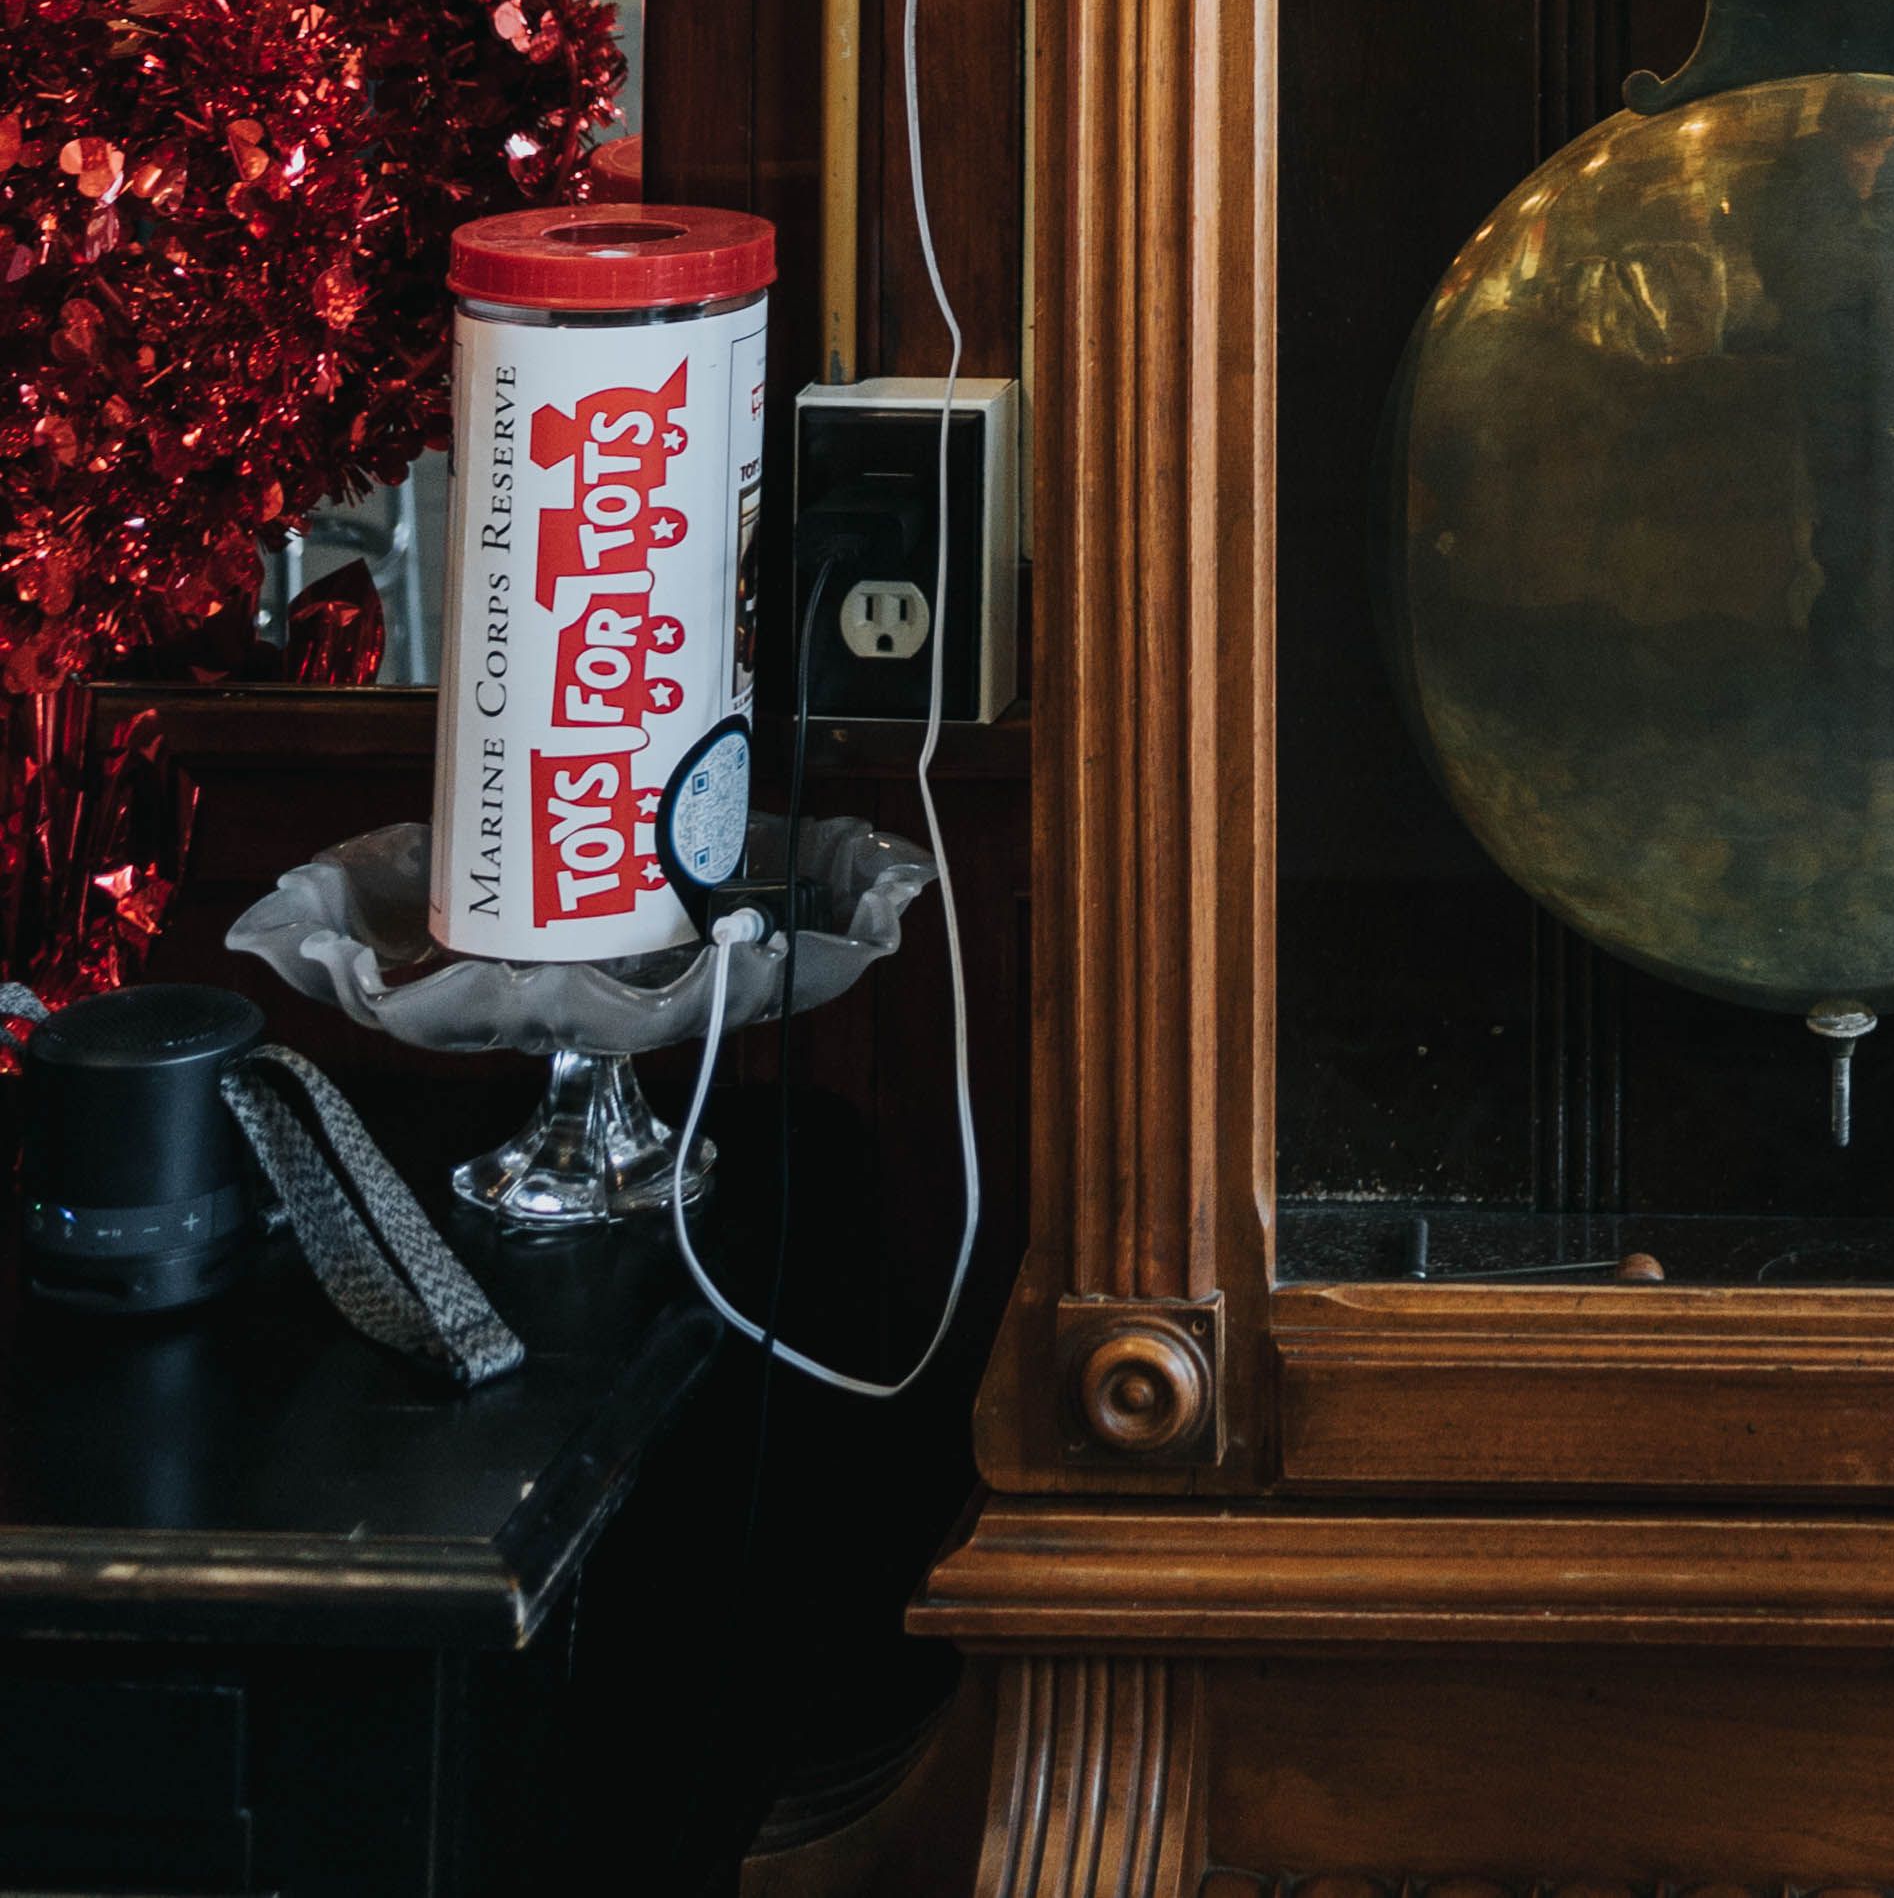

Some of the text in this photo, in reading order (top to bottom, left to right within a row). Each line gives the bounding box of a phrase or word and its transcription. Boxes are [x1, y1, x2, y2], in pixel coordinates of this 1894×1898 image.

[469, 365, 517, 920] MARINE CORPS RESERVE
[547, 410, 655, 913] TOYS FOR TOTS
